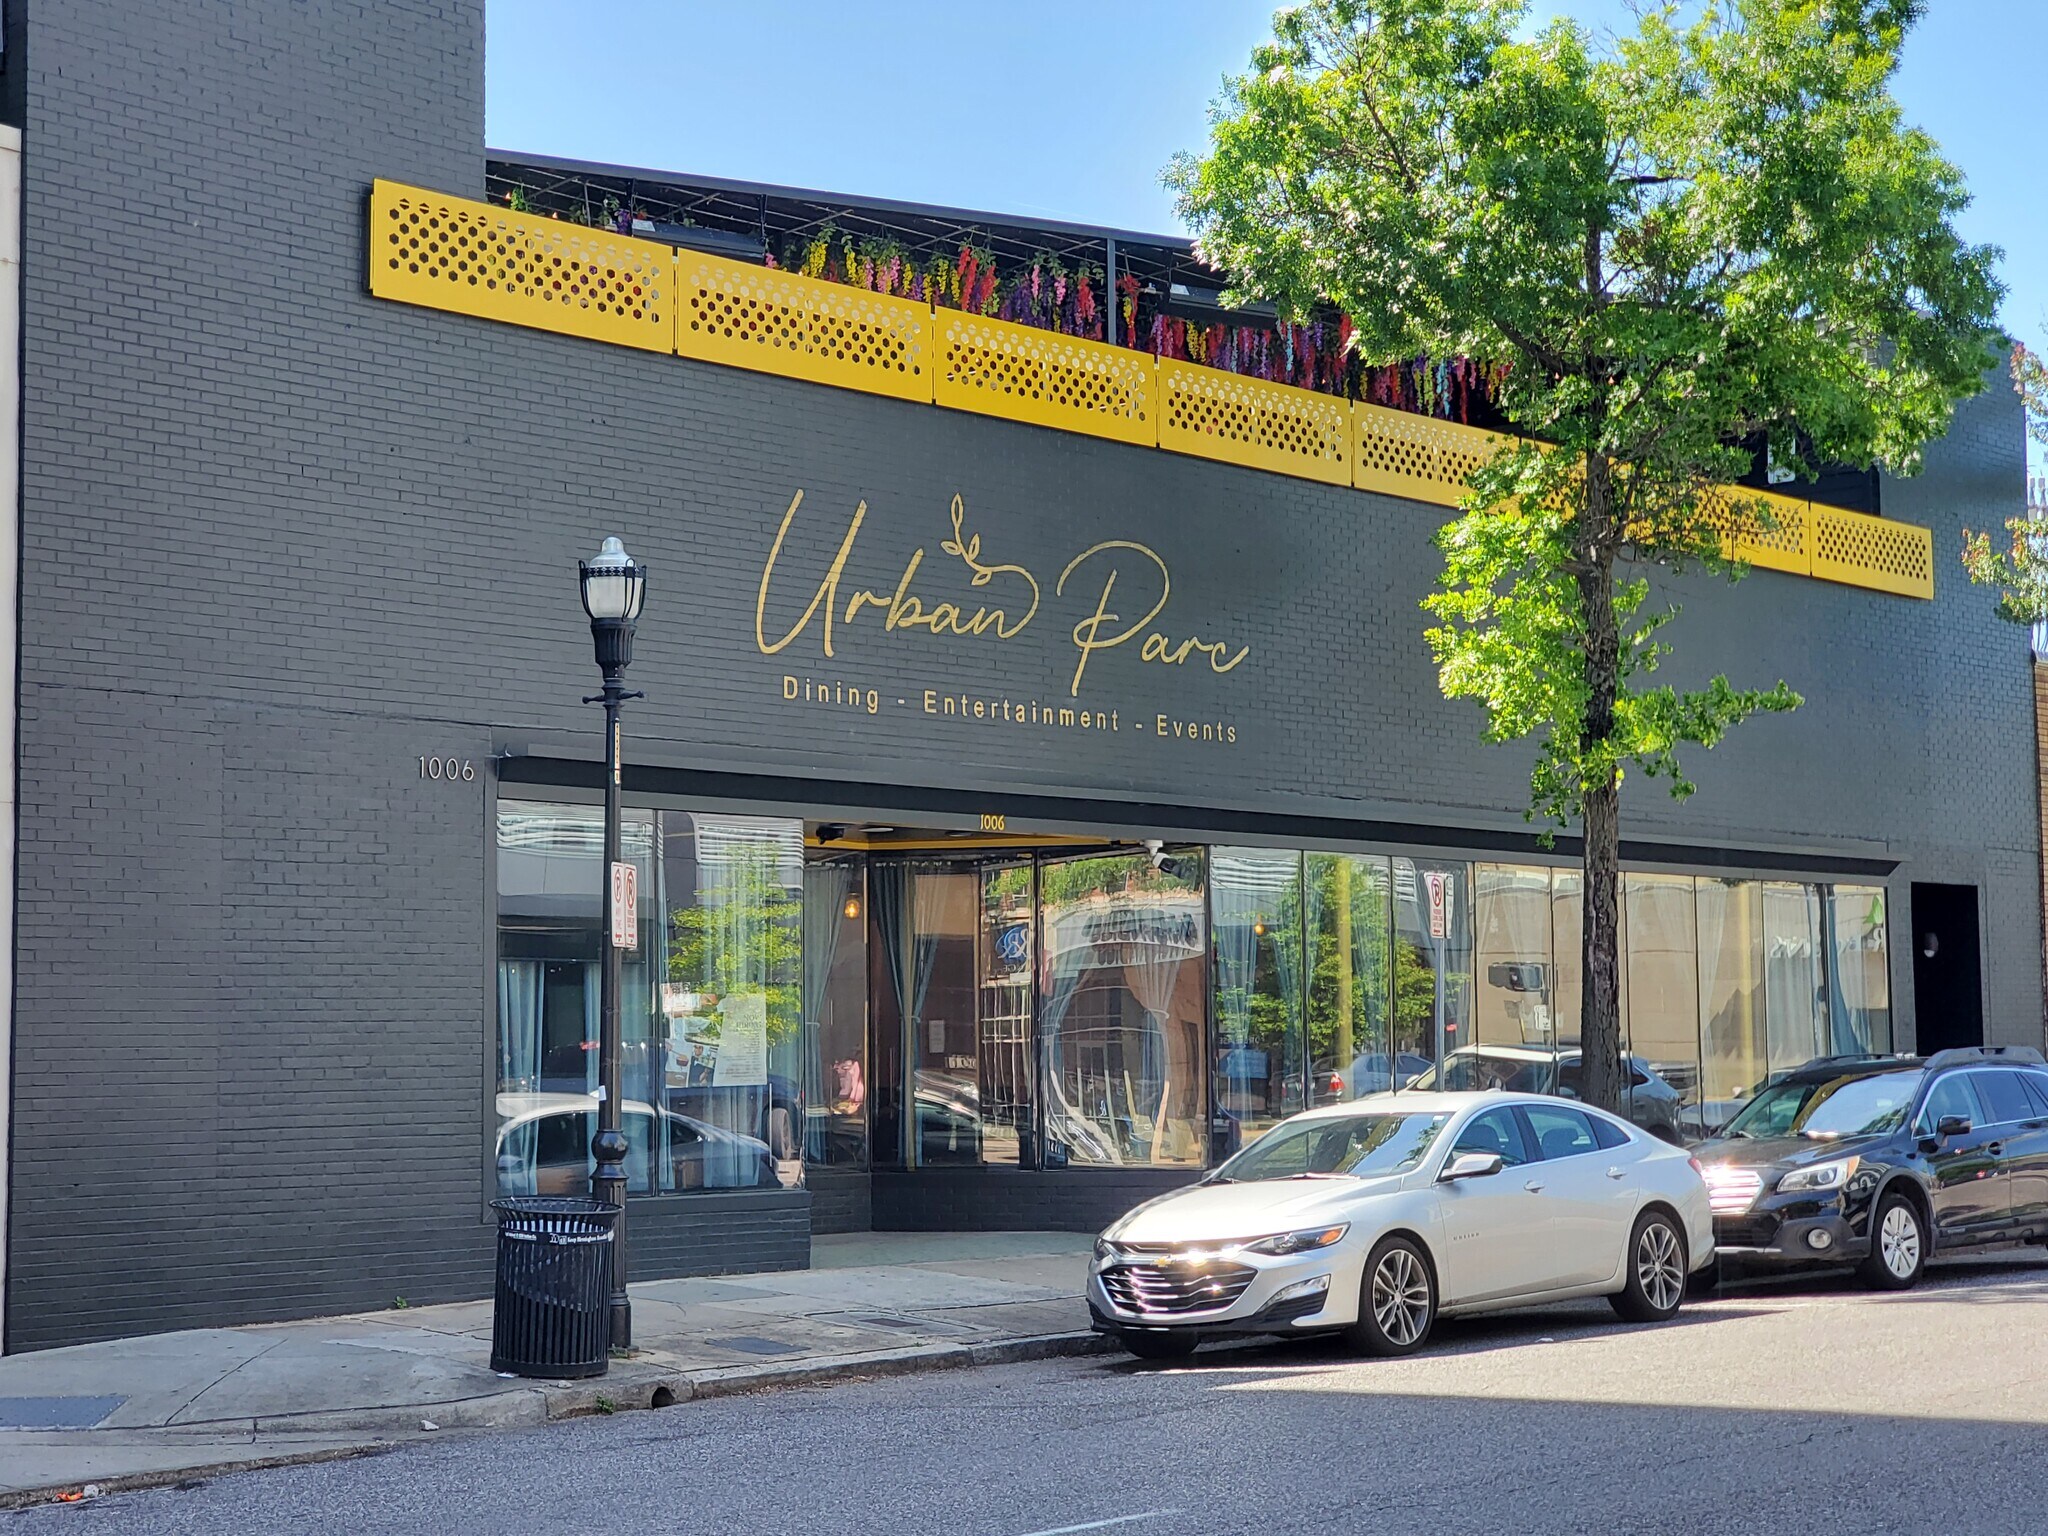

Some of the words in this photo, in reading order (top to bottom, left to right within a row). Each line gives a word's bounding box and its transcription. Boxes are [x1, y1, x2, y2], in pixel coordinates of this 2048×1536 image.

[755, 490, 1040, 658] Urban
[1057, 540, 1250, 696] Parc
[783, 675, 879, 715] Dining
[924, 689, 1120, 731] Entertainment
[1156, 714, 1238, 743] Events
[418, 756, 475, 781] 1006
[980, 814, 1005, 831] 1006
